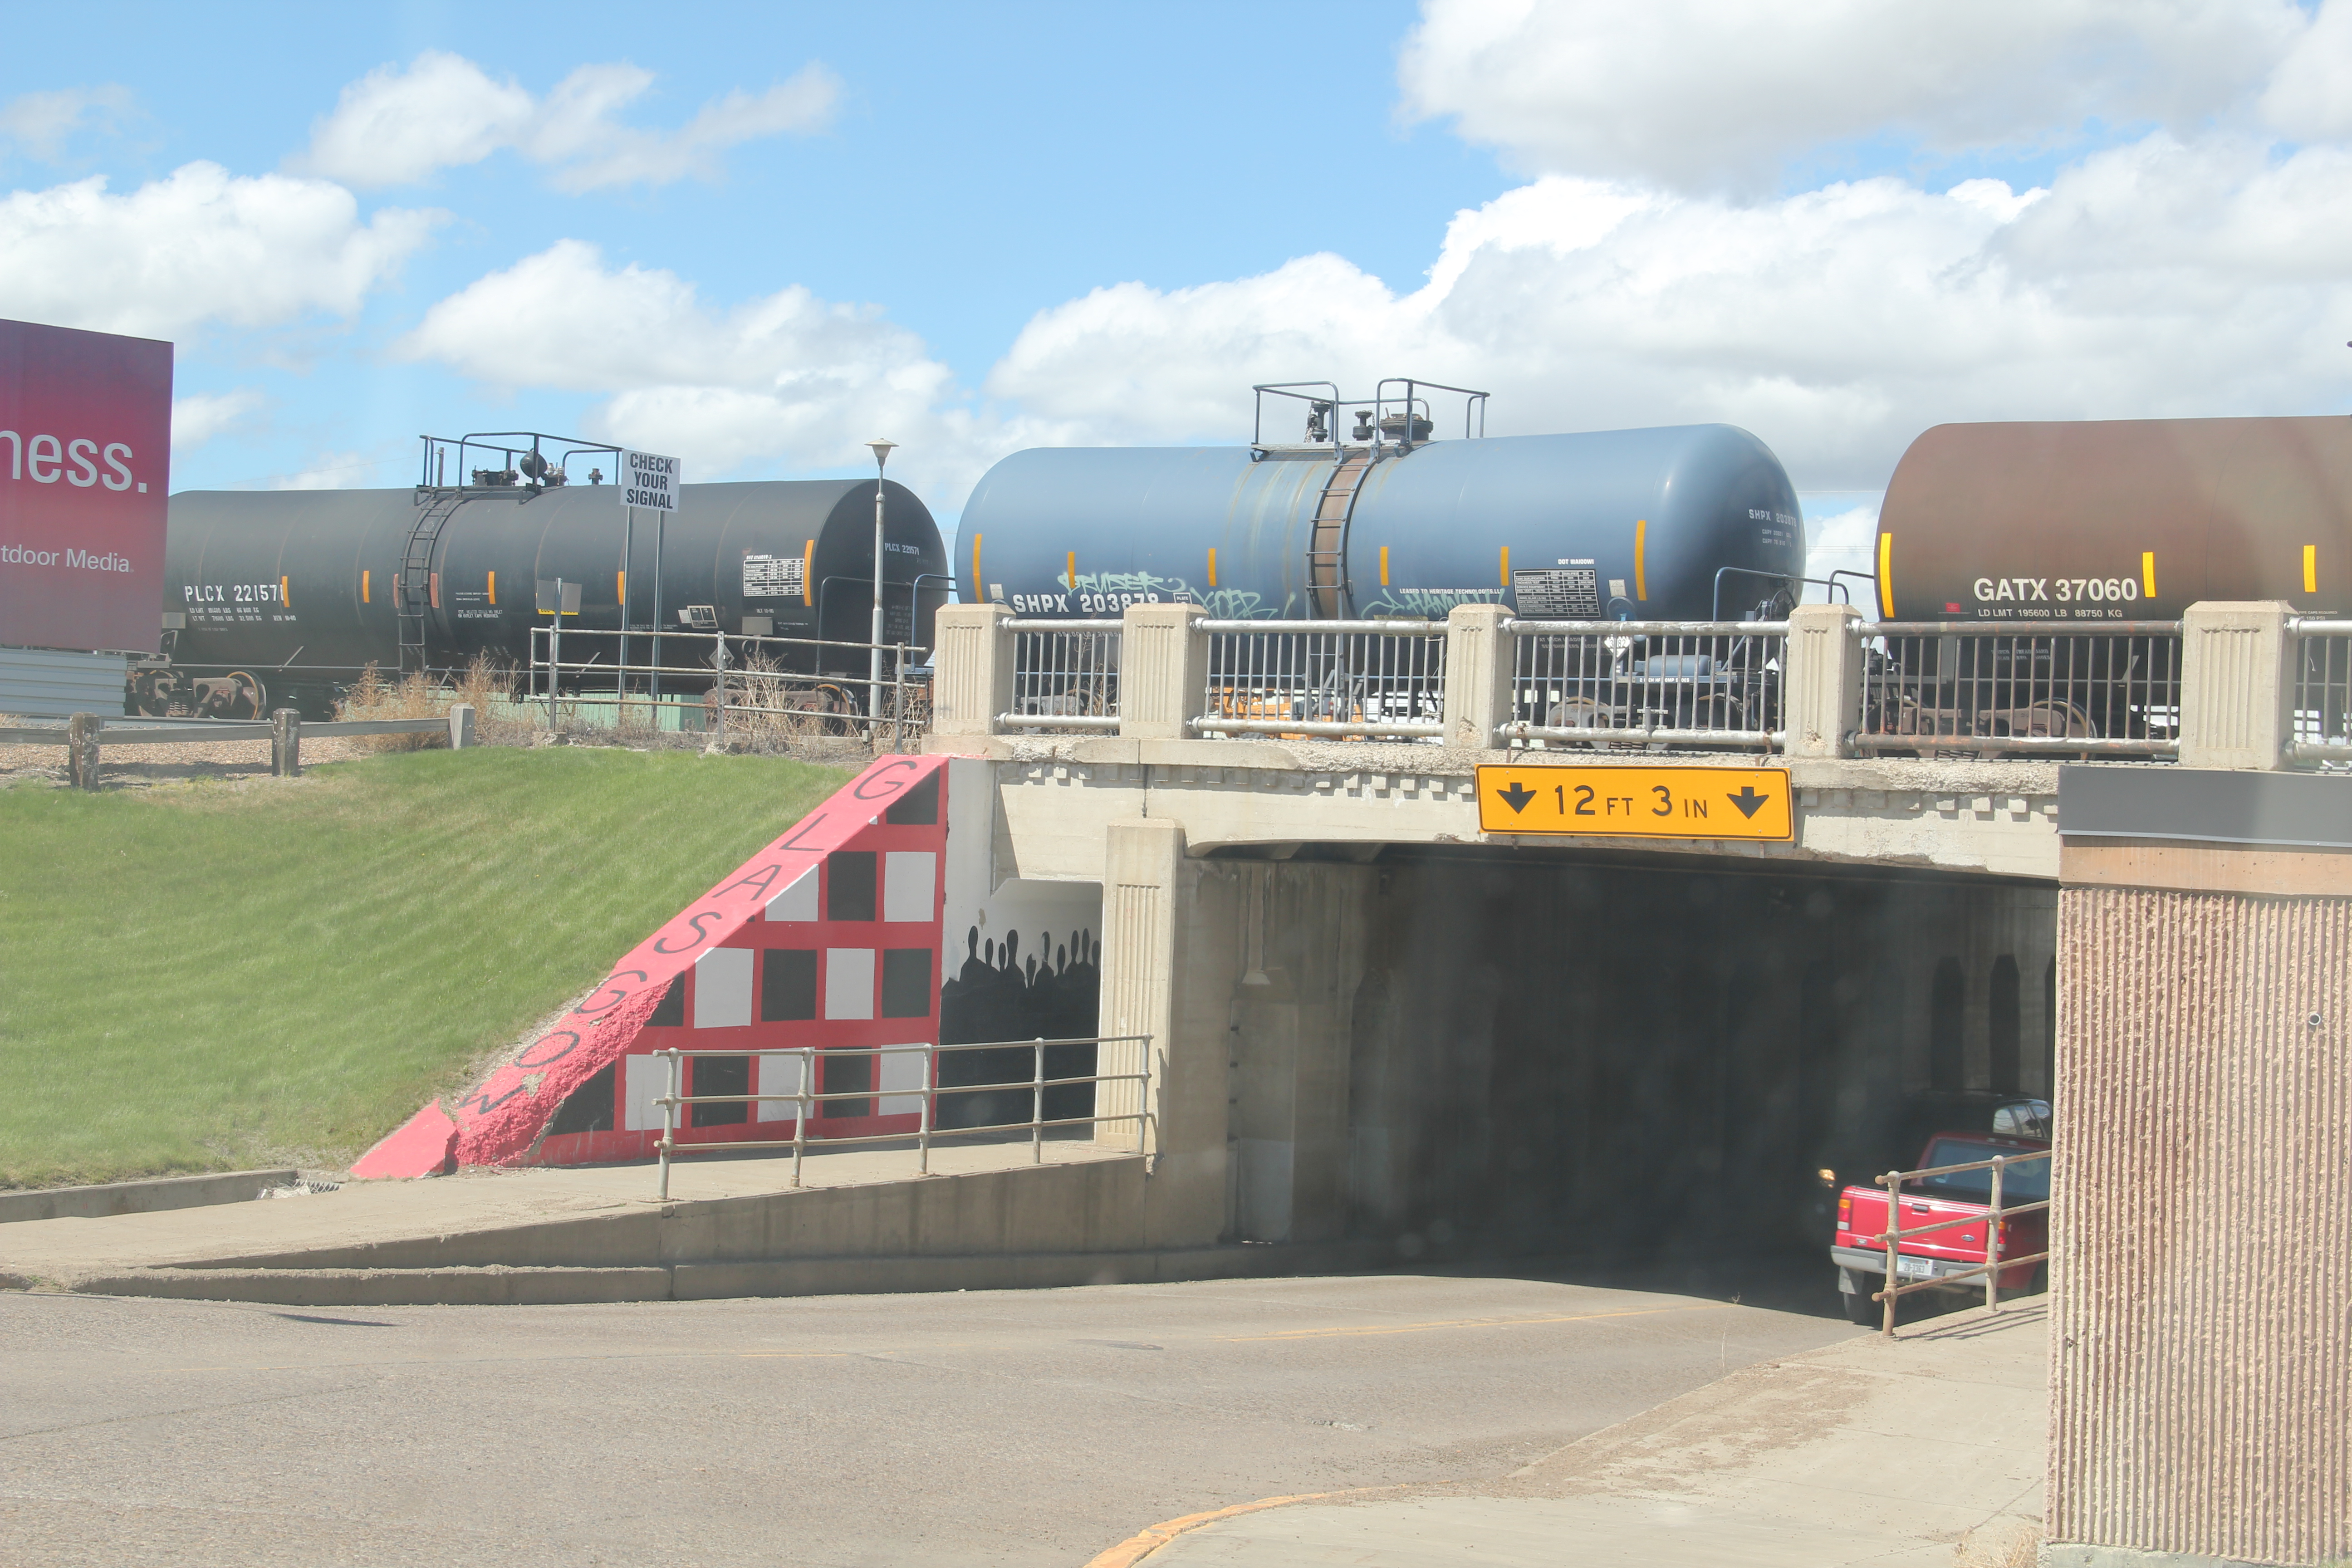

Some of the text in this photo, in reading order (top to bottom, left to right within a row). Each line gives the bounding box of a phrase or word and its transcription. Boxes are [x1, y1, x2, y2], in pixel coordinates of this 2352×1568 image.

[630, 453, 673, 474] CHECK
[634, 471, 668, 490] YOUR
[626, 489, 673, 510] SIGNAL
[1749, 509, 1797, 527] SHPX 203878
[0, 544, 60, 566] tdoor
[885, 543, 919, 556] PLCX 221571
[185, 584, 284, 602] PLCX 221571
[1974, 578, 2137, 602] GATX 37060
[1013, 593, 1070, 612] SHPX
[1978, 609, 2123, 617] LD LMT 195600 LB 88750 KG
[1555, 785, 1707, 818] 12 FT 3 IN
[457, 760, 918, 1115] GLASGOW
